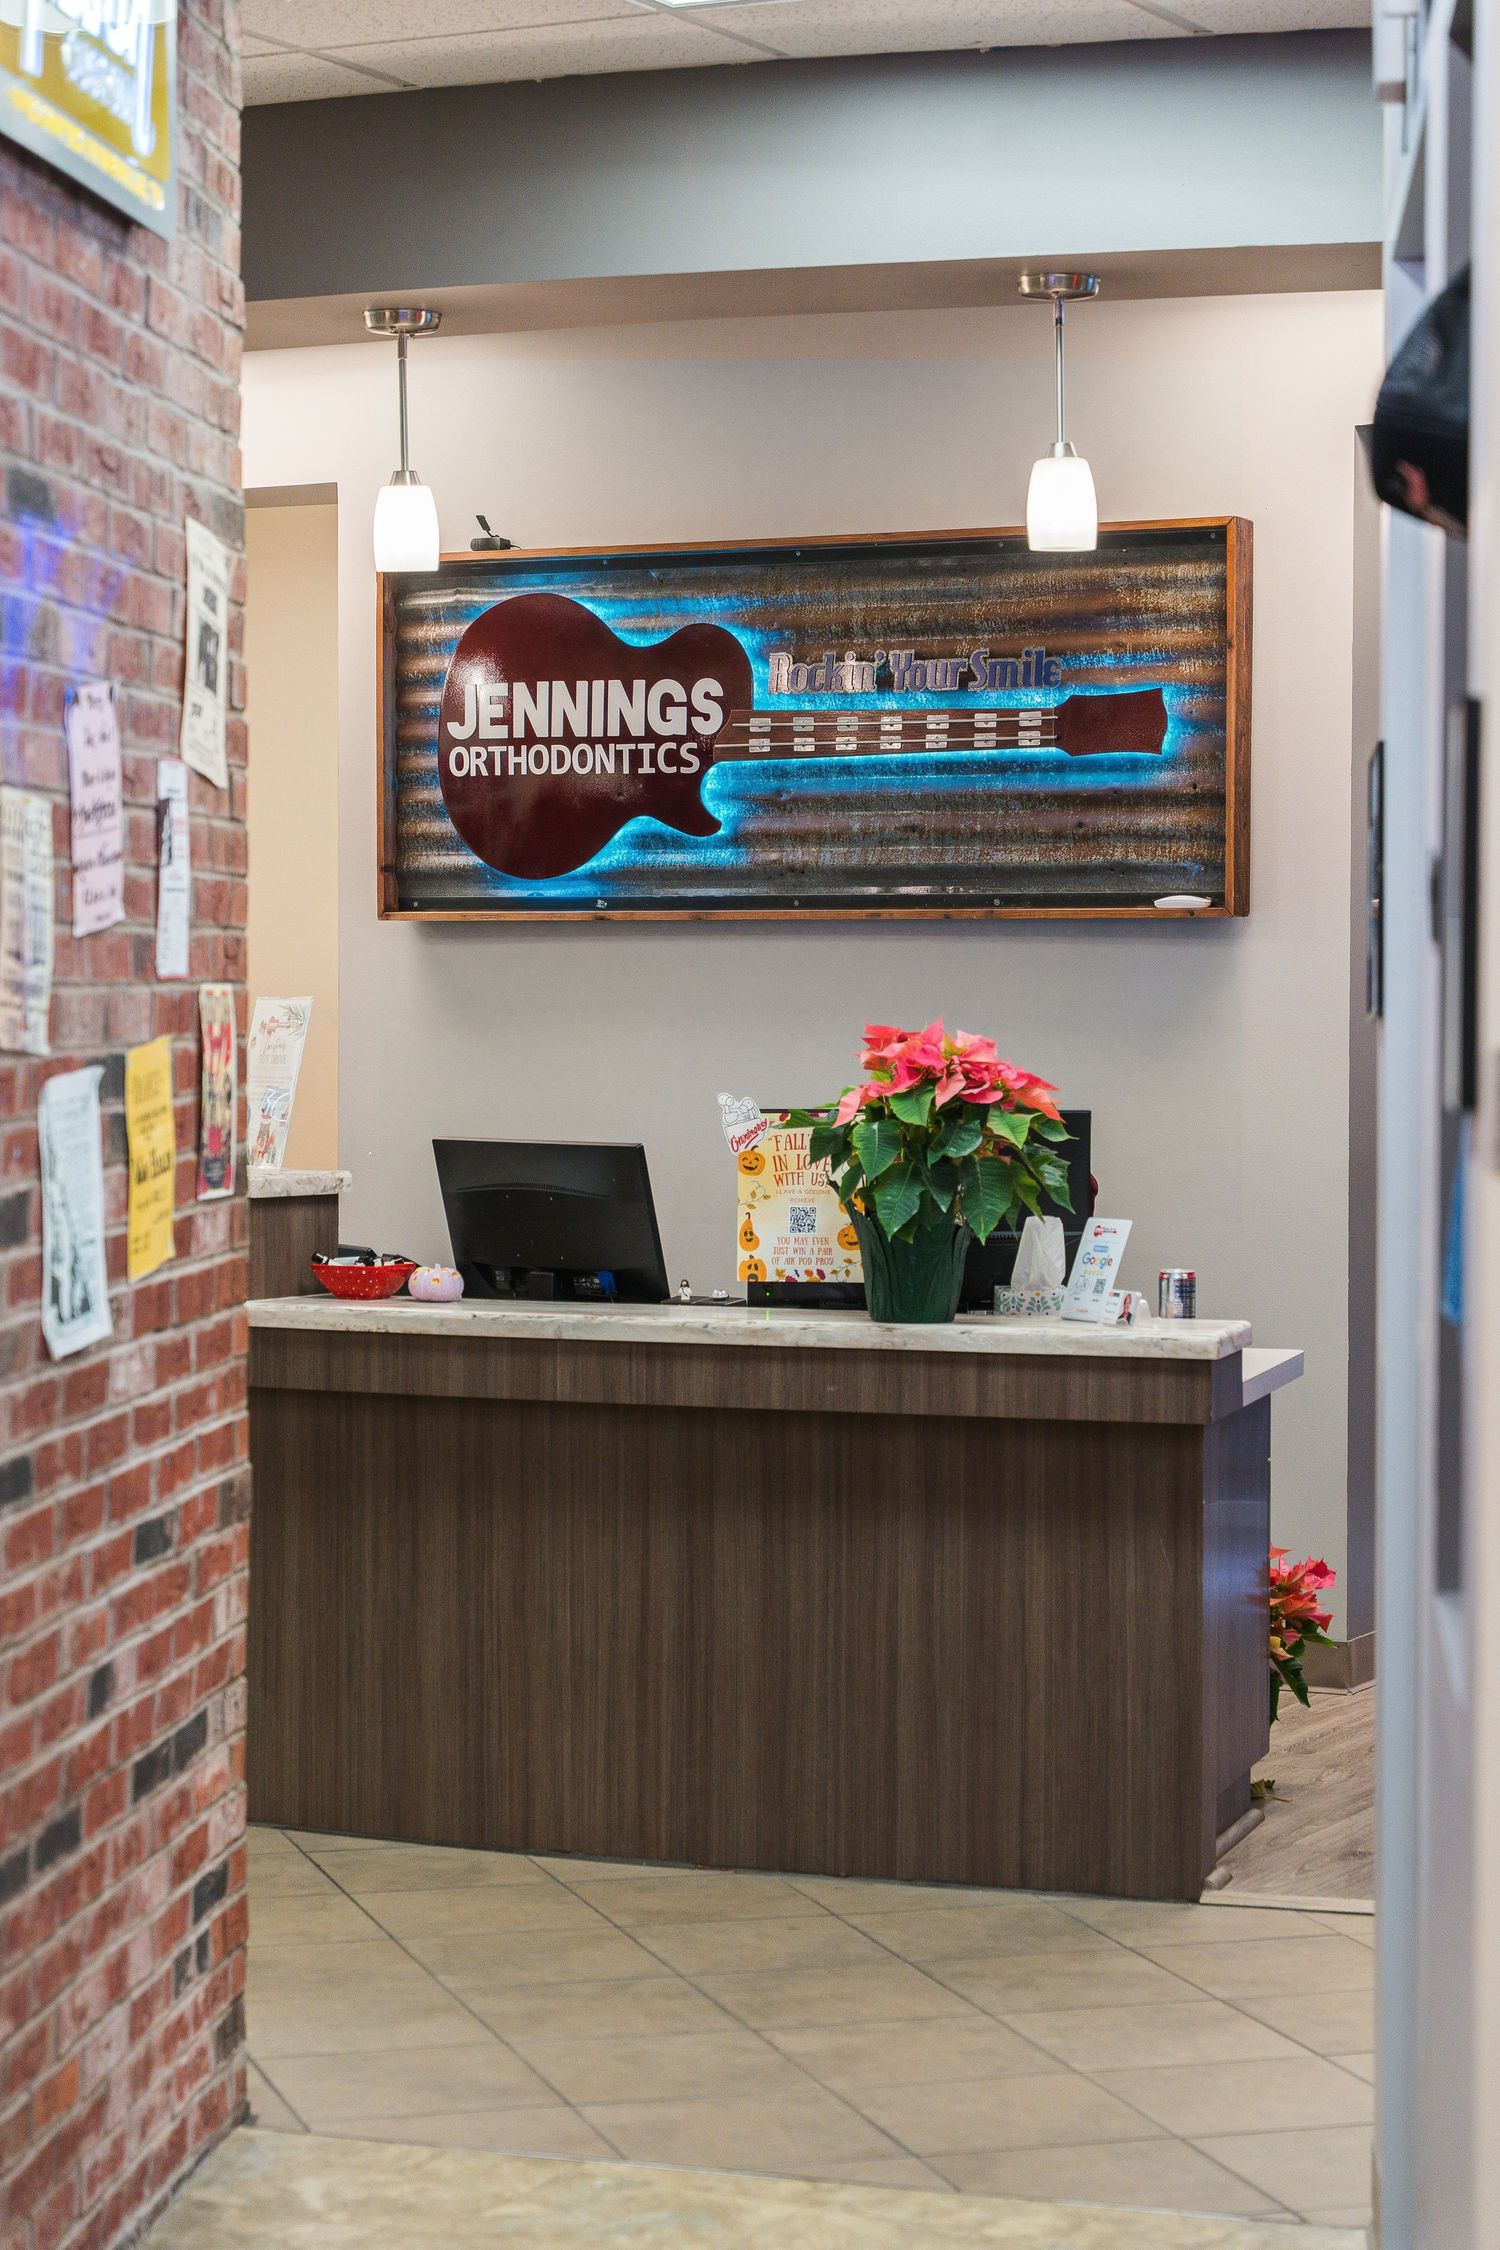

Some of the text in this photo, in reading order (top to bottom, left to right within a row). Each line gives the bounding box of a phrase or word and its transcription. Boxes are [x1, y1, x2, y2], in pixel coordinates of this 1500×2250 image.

[768, 646, 1063, 693] Rockin' Your Smile
[446, 677, 724, 740] JENNINGS
[449, 742, 700, 777] ORTHODONTICS
[773, 1154, 788, 1172] IN
[773, 1172, 804, 1188] WITH
[776, 1236, 830, 1245] YOU MAY EVEN
[772, 1246, 833, 1256] JUST WIN A PAIR
[771, 1257, 780, 1265] OF
[784, 1257, 795, 1265] AIR
[798, 1257, 813, 1265] POD
[1082, 1252, 1113, 1270] Google
